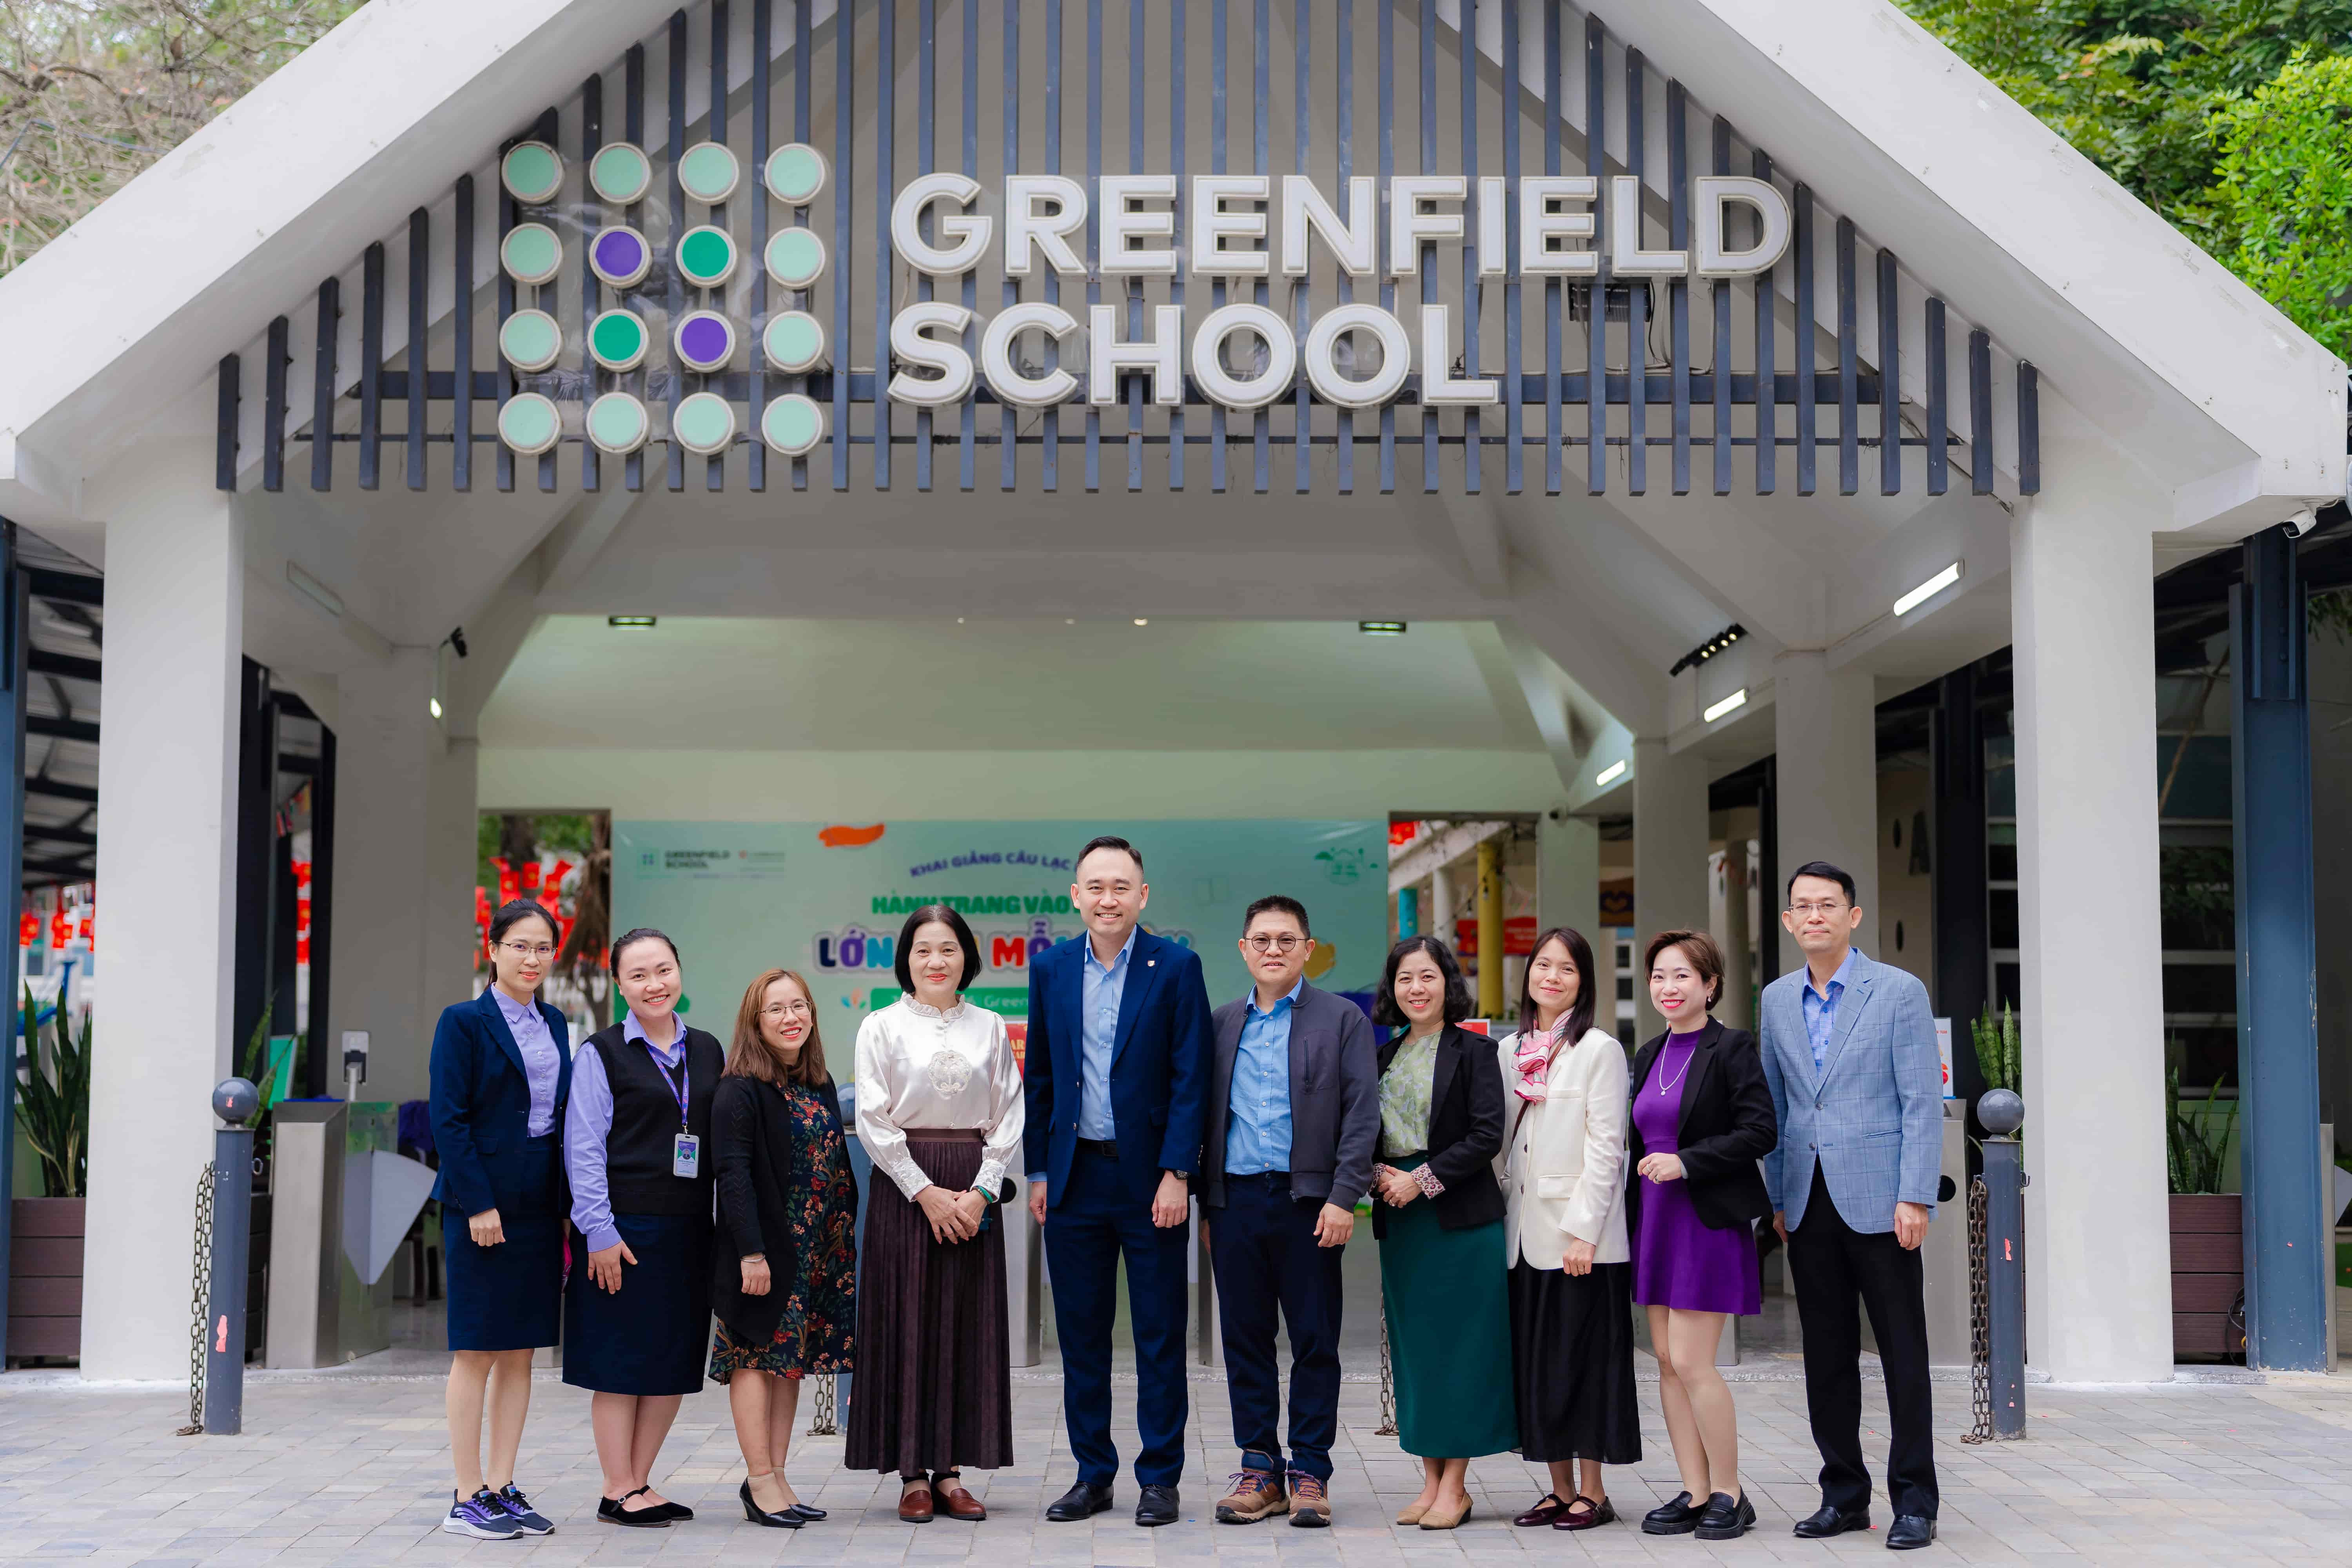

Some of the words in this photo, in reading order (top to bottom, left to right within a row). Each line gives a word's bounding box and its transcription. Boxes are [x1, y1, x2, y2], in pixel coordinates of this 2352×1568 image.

[890, 171, 1794, 278] GREENFIELD
[887, 301, 1500, 410] SCHOOL
[910, 858, 948, 877] KHAI
[940, 895, 1021, 915] TRANG
[1023, 888, 1070, 915] VÀO
[819, 929, 893, 968] LỚN
[992, 921, 1067, 967] MỖ
